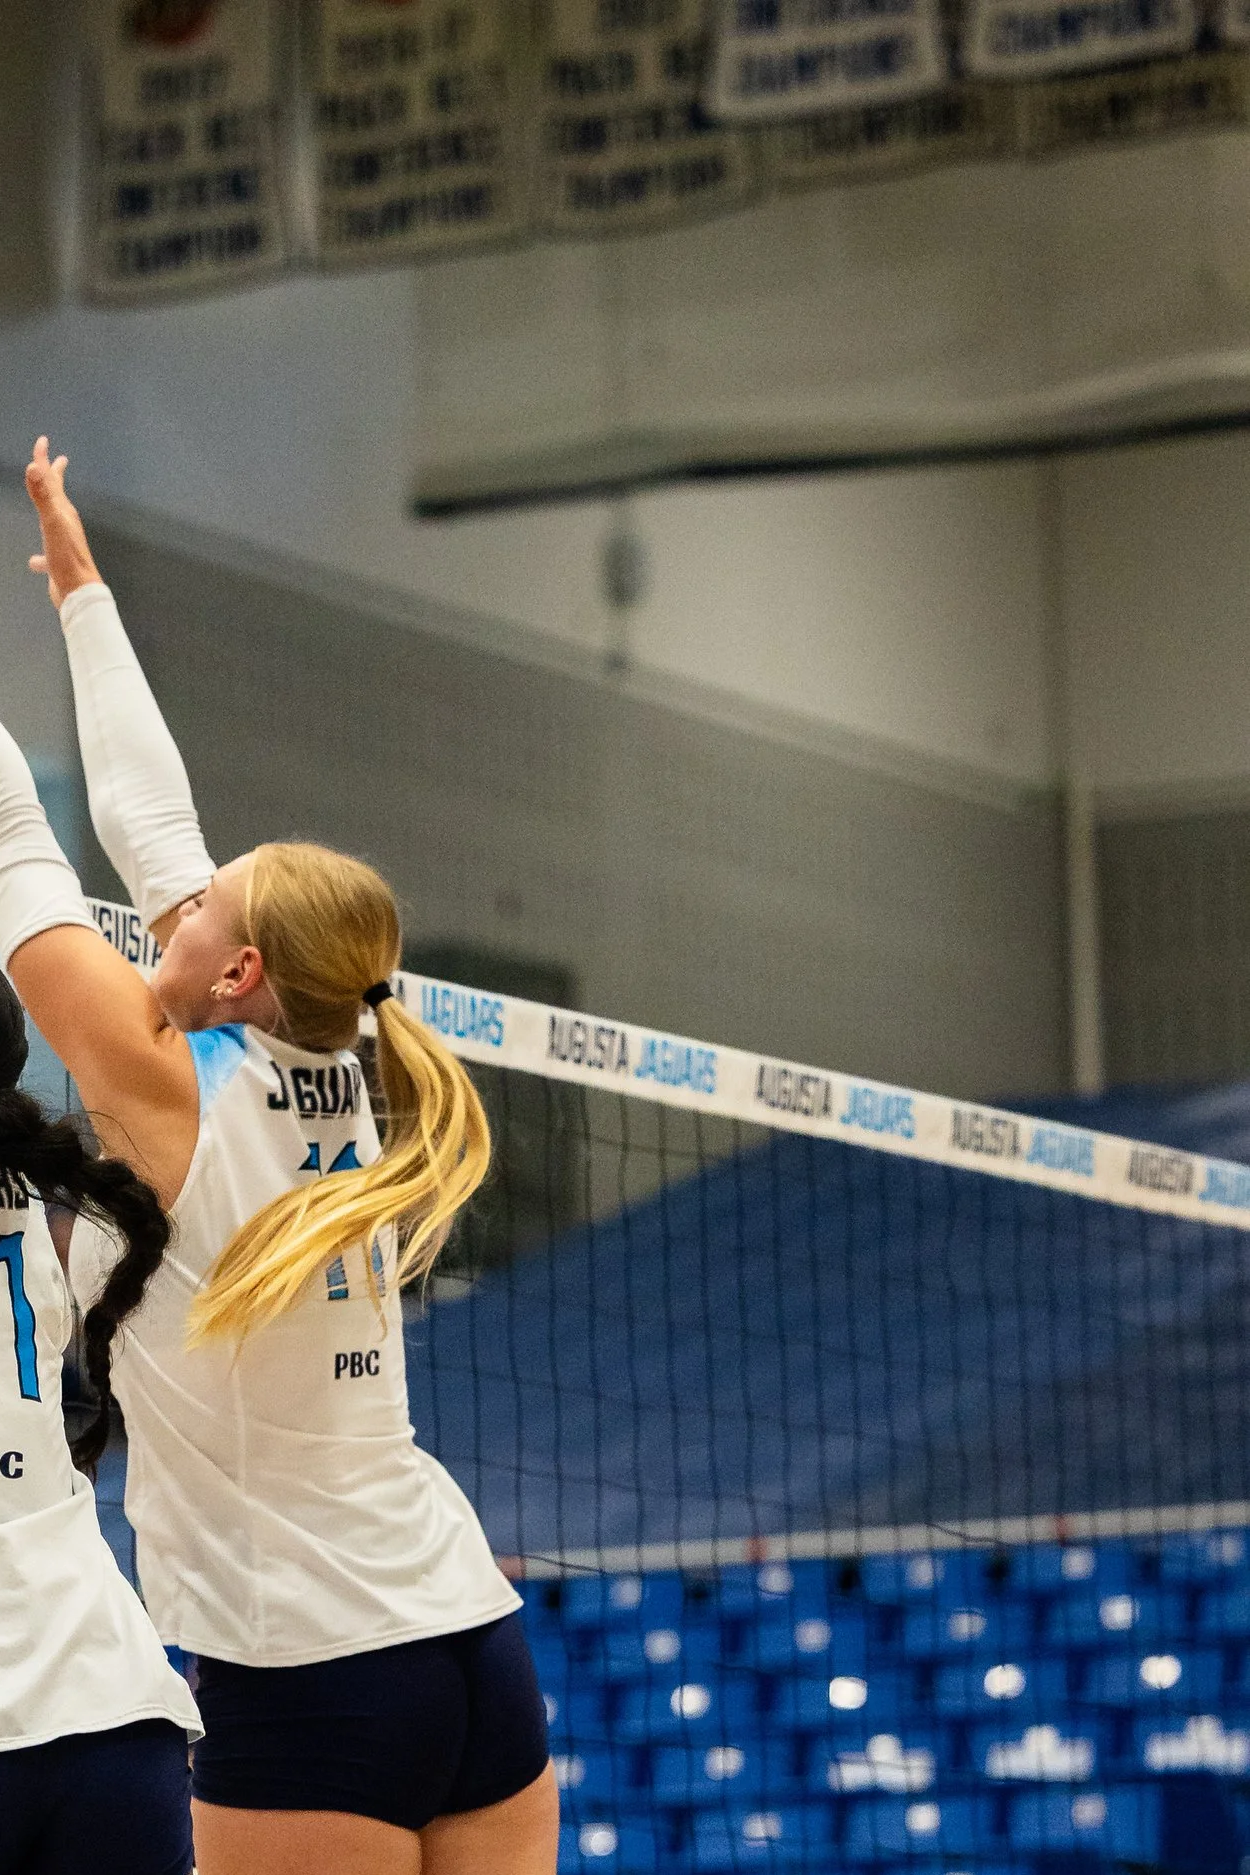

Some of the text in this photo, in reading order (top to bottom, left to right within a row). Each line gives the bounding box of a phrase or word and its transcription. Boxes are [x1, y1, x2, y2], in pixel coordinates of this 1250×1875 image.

[548, 1012, 717, 1094] AUGUSTA JAGUARS
[755, 1063, 915, 1139] AUGUSTA JAGUARS
[334, 1350, 381, 1380] PBC
